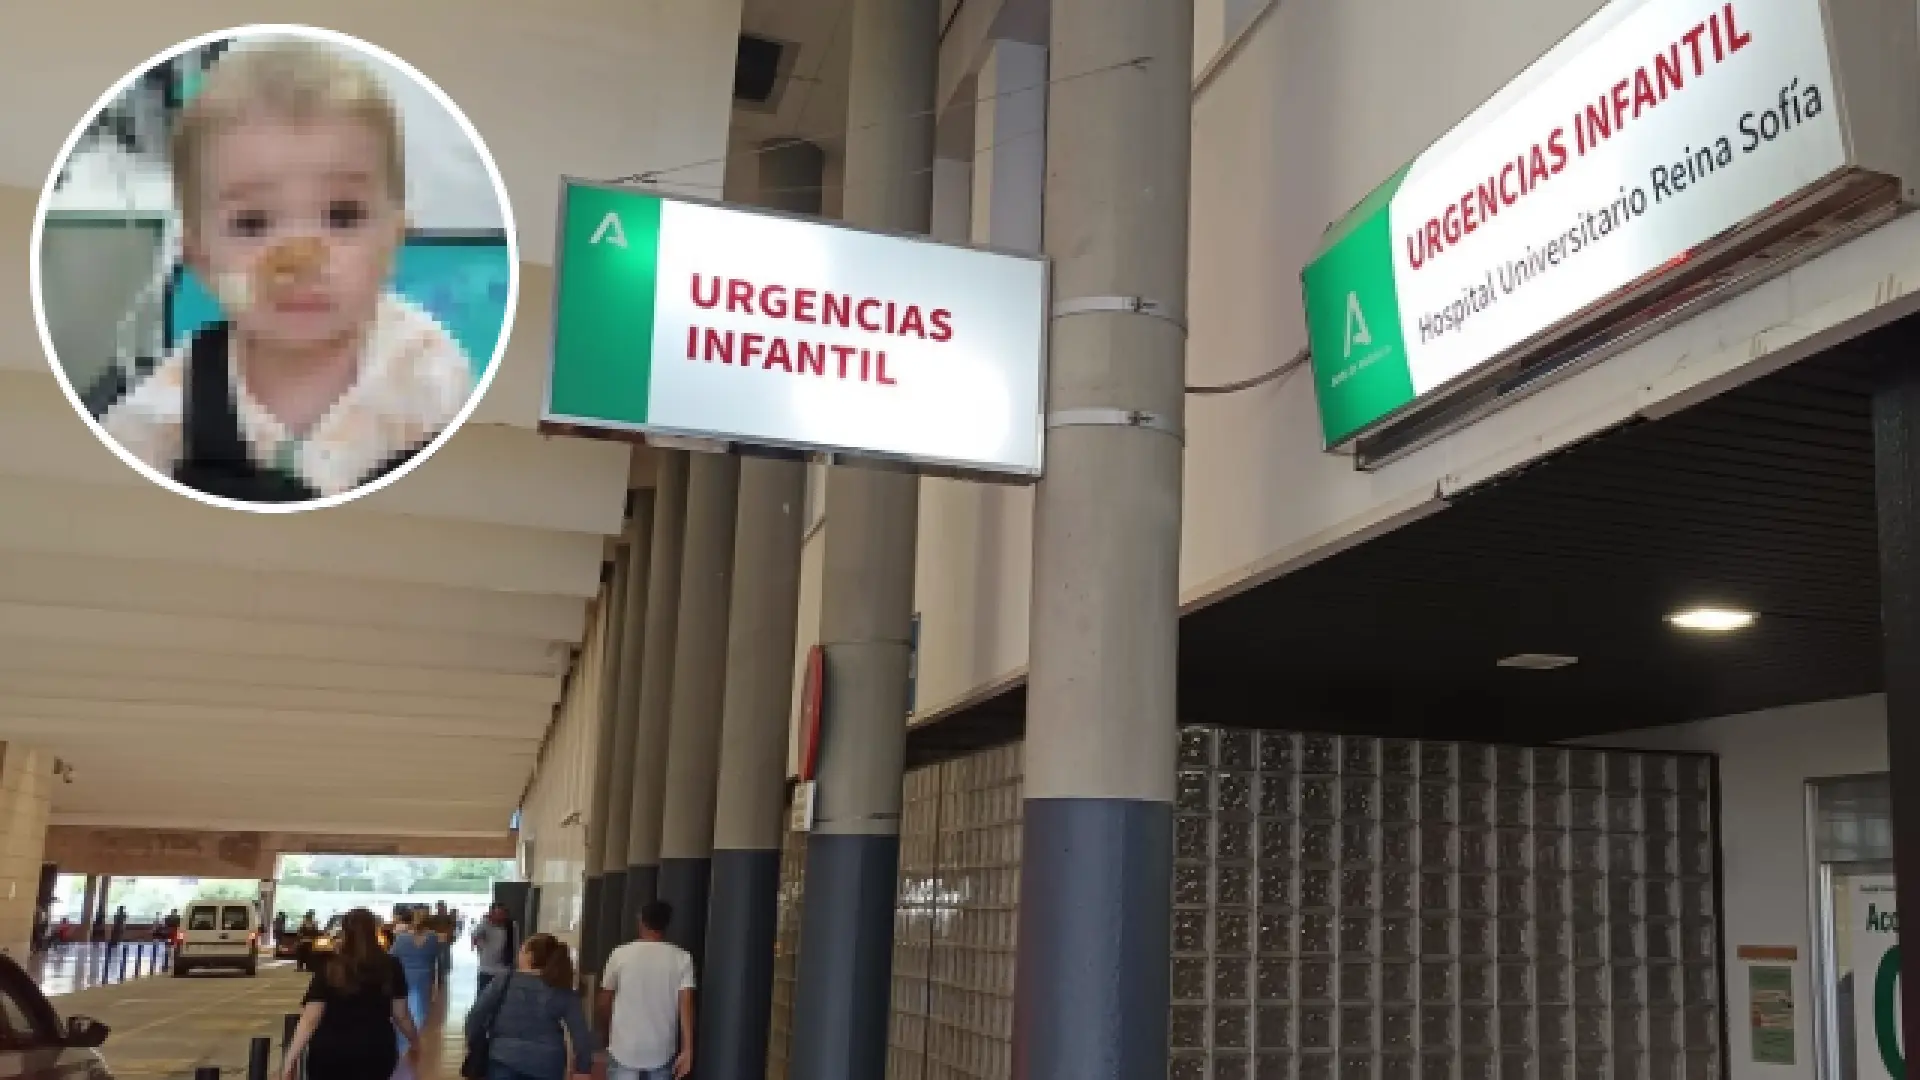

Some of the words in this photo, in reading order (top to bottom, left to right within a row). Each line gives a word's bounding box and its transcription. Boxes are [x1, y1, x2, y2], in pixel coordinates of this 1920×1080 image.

[1407, 127, 1568, 270] URGENCIAS
[1574, 4, 1751, 156] INFANTIL
[1418, 270, 1498, 345] Hospital
[1497, 186, 1647, 295] Universitario
[1650, 135, 1733, 204] Reina
[1738, 76, 1823, 153] Sofía
[686, 326, 897, 385] INFANTIL
[690, 273, 953, 342] URGENCIAS
